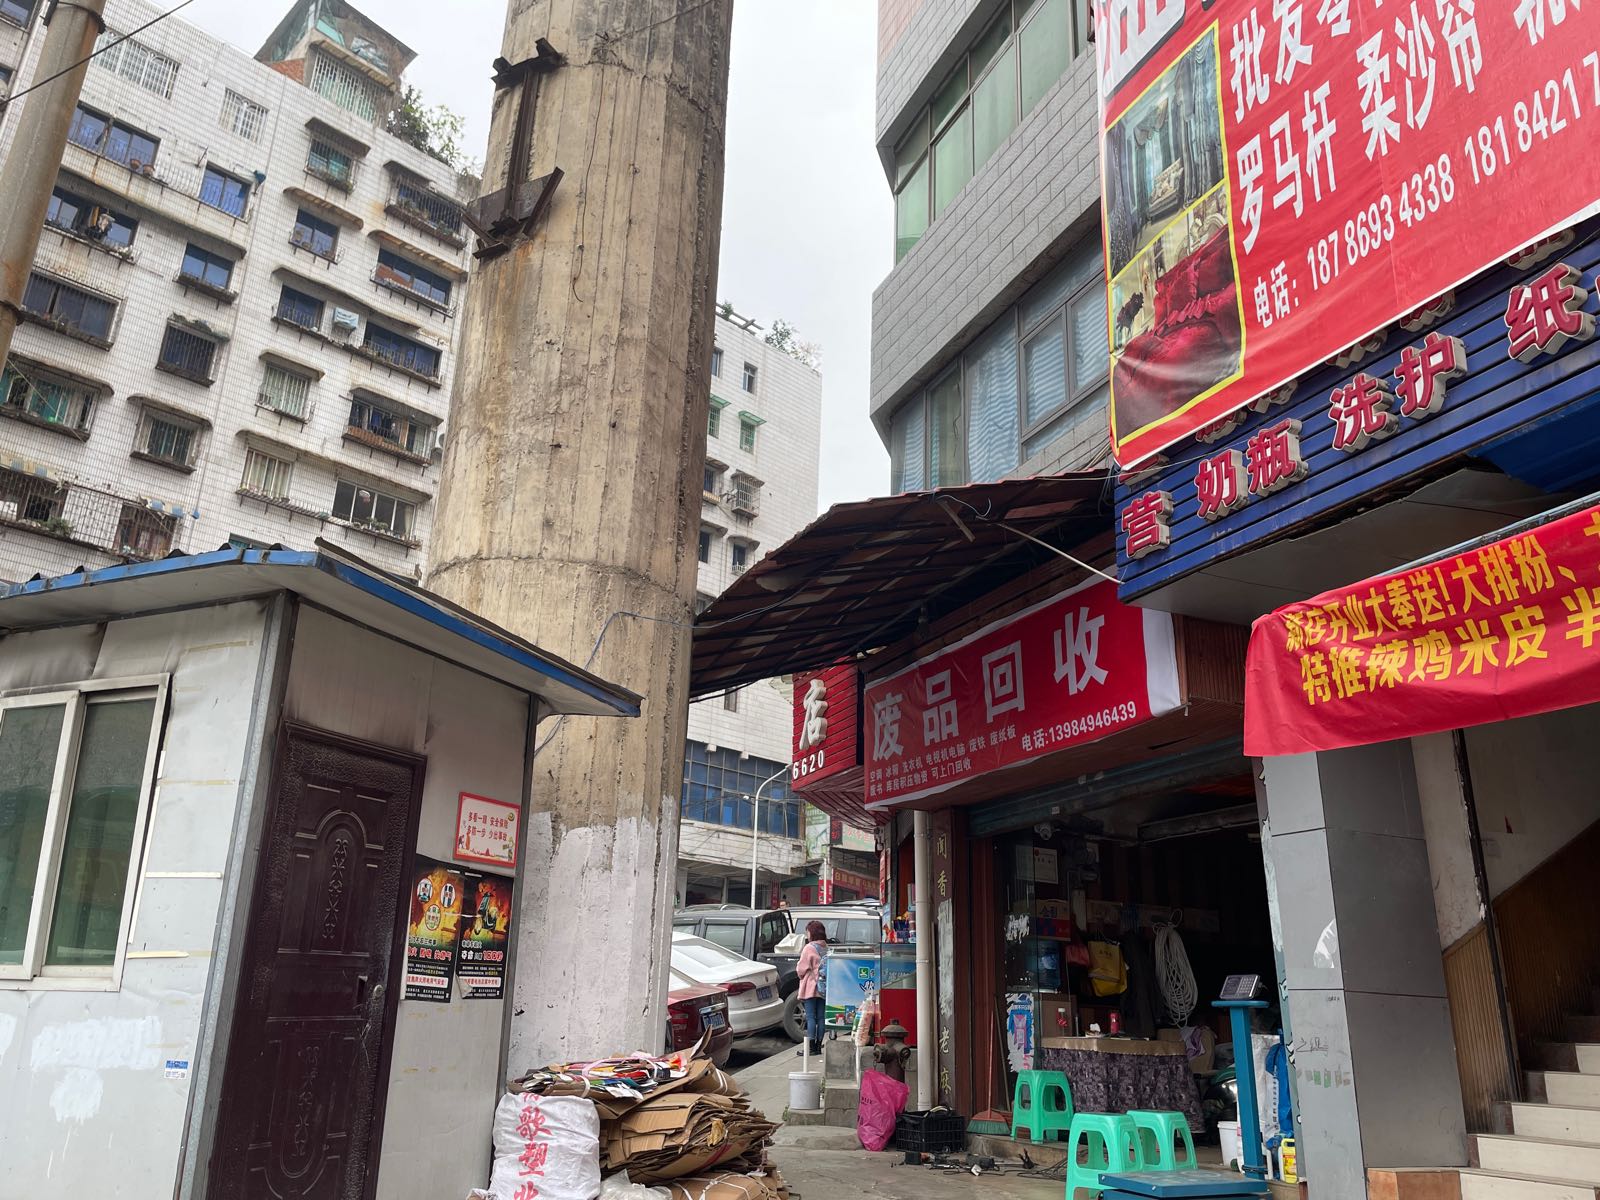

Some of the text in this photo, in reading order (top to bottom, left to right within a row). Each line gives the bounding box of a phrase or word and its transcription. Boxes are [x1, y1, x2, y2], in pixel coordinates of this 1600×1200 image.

[1230, 0, 1384, 124] 批发
[1236, 81, 1338, 255] 罗马杆
[1357, 0, 1483, 162] 柔沙帘
[1195, 418, 1298, 521] 奶瓶
[1328, 331, 1460, 452] 洗护
[1504, 262, 1600, 363] 纸
[1284, 511, 1600, 652] 新店开业大奉送!大排粉、
[872, 606, 1109, 761] 废品回收
[1300, 604, 1549, 706] 特推辣鸡米皮
[792, 749, 824, 780] 6620
[931, 757, 972, 780] 可上门回收
